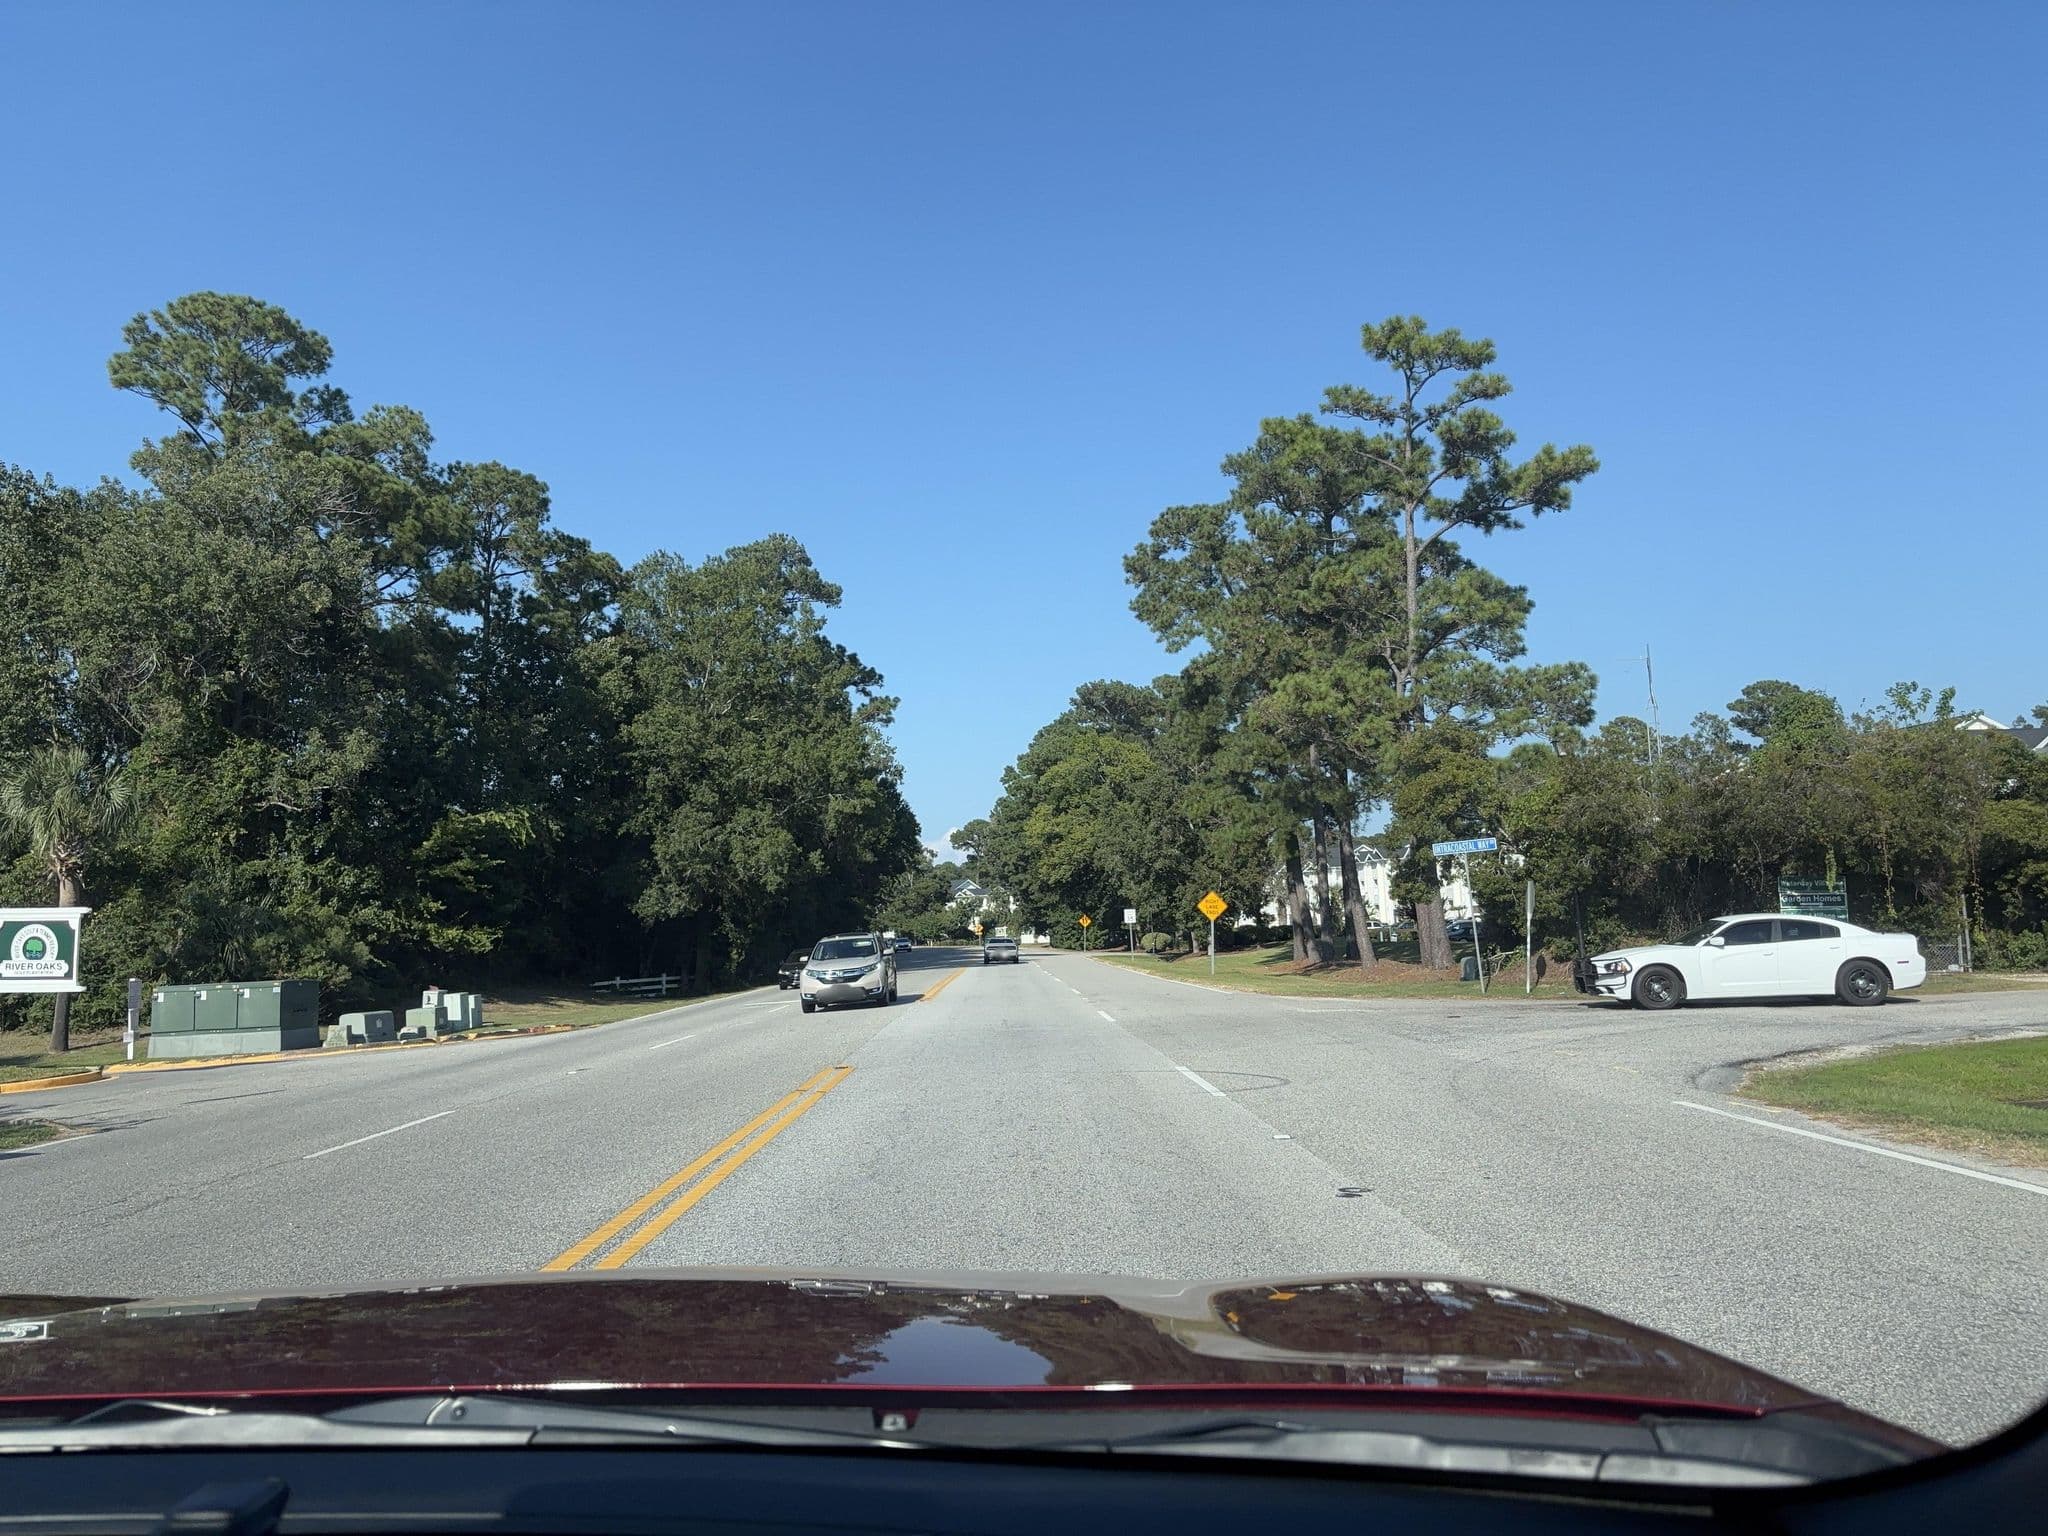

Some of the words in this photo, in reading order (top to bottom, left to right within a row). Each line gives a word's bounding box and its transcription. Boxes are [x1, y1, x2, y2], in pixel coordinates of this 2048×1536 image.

[1477, 839, 1489, 849] WAY
[1781, 895, 1811, 903] Garden
[5, 962, 34, 971] RIVER
[35, 962, 63, 971] OAKS
